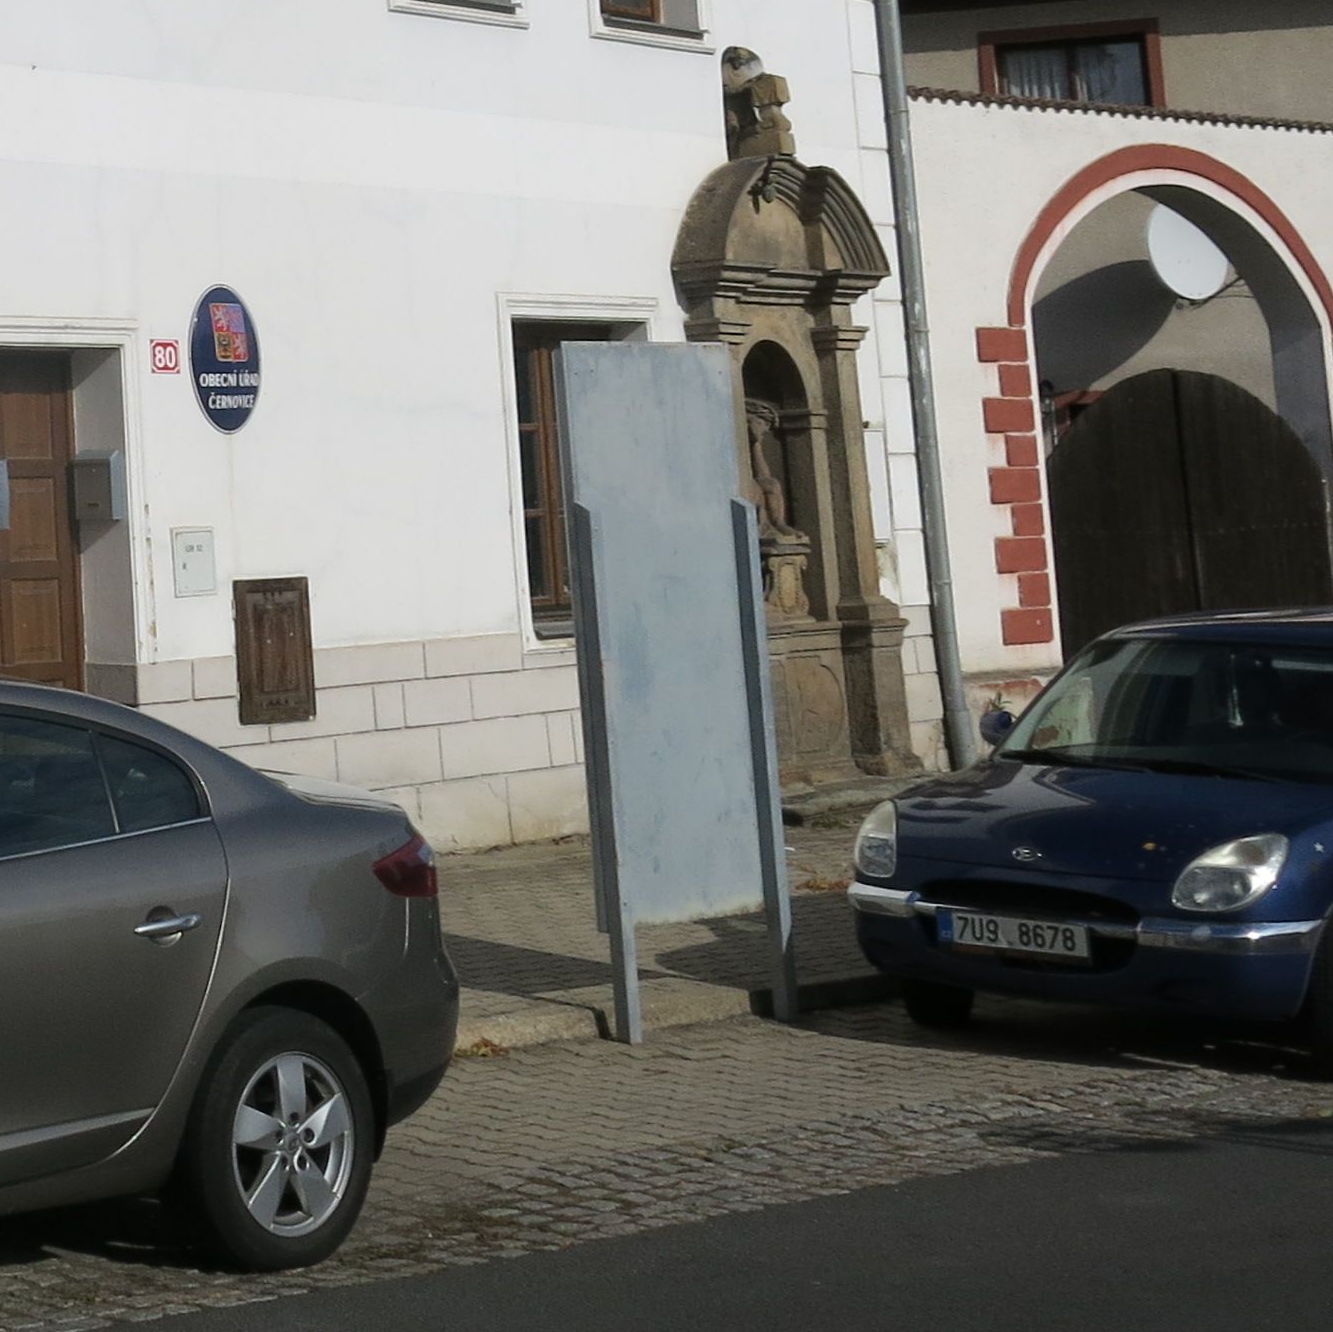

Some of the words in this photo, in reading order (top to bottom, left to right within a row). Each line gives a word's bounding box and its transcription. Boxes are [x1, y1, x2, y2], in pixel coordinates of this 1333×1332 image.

[154, 345, 176, 368] 80
[199, 369, 238, 387] OBECNÍ
[208, 392, 254, 409] ČERNOVICE
[957, 916, 999, 943] 7U9
[1017, 922, 1076, 952] 8678
